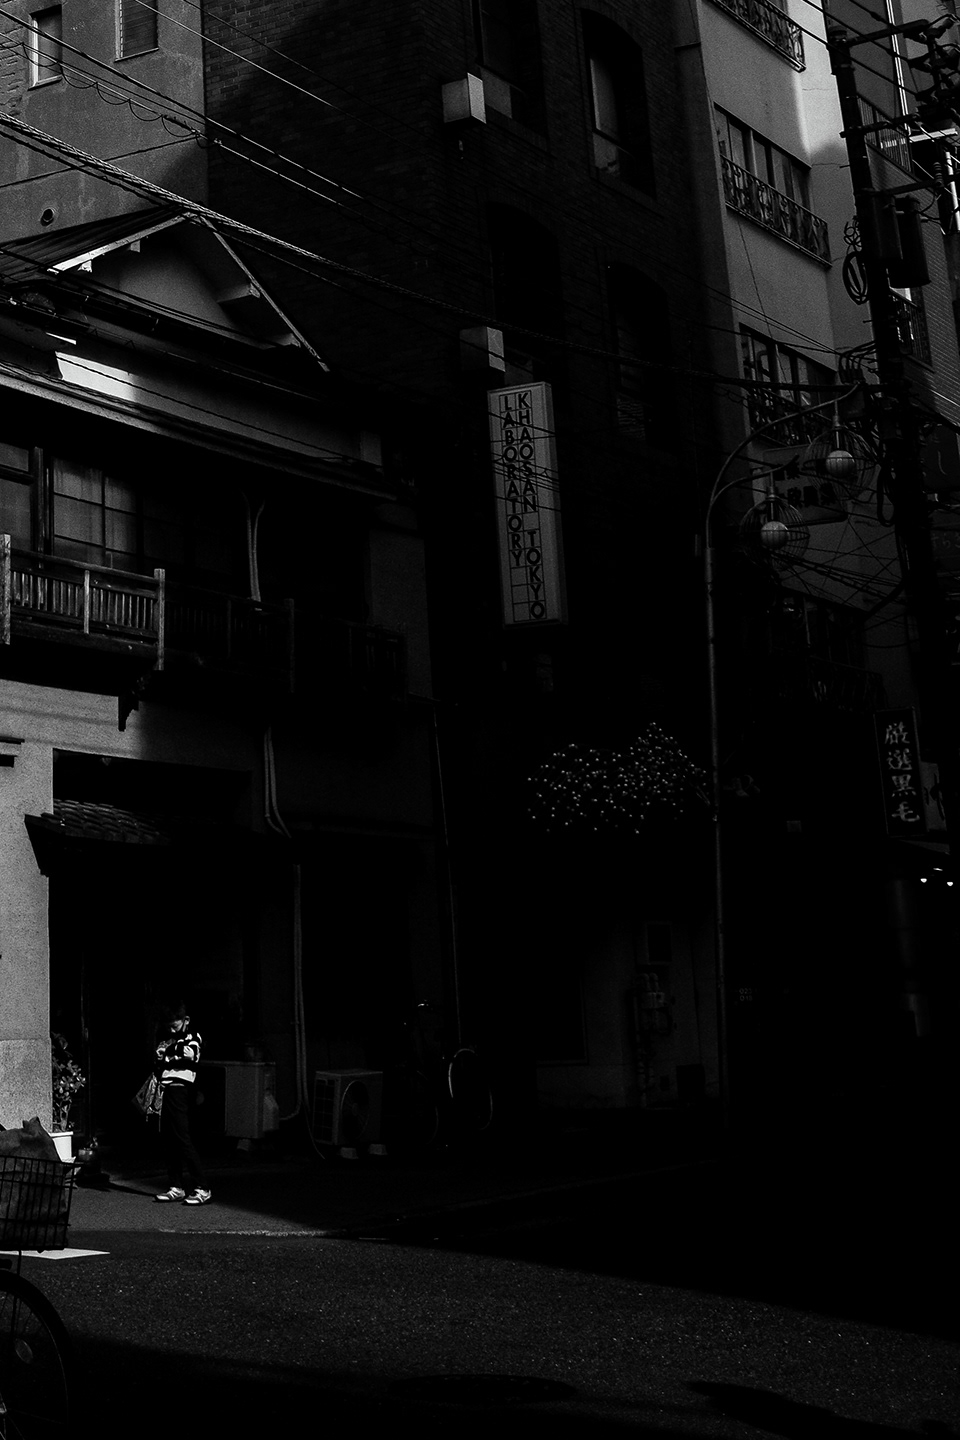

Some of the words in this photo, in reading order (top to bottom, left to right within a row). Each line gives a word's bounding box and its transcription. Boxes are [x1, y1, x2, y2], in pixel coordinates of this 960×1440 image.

[503, 395, 523, 566] LABORATORY
[518, 393, 537, 512] KHAOSAN
[526, 531, 545, 619] TOKYO
